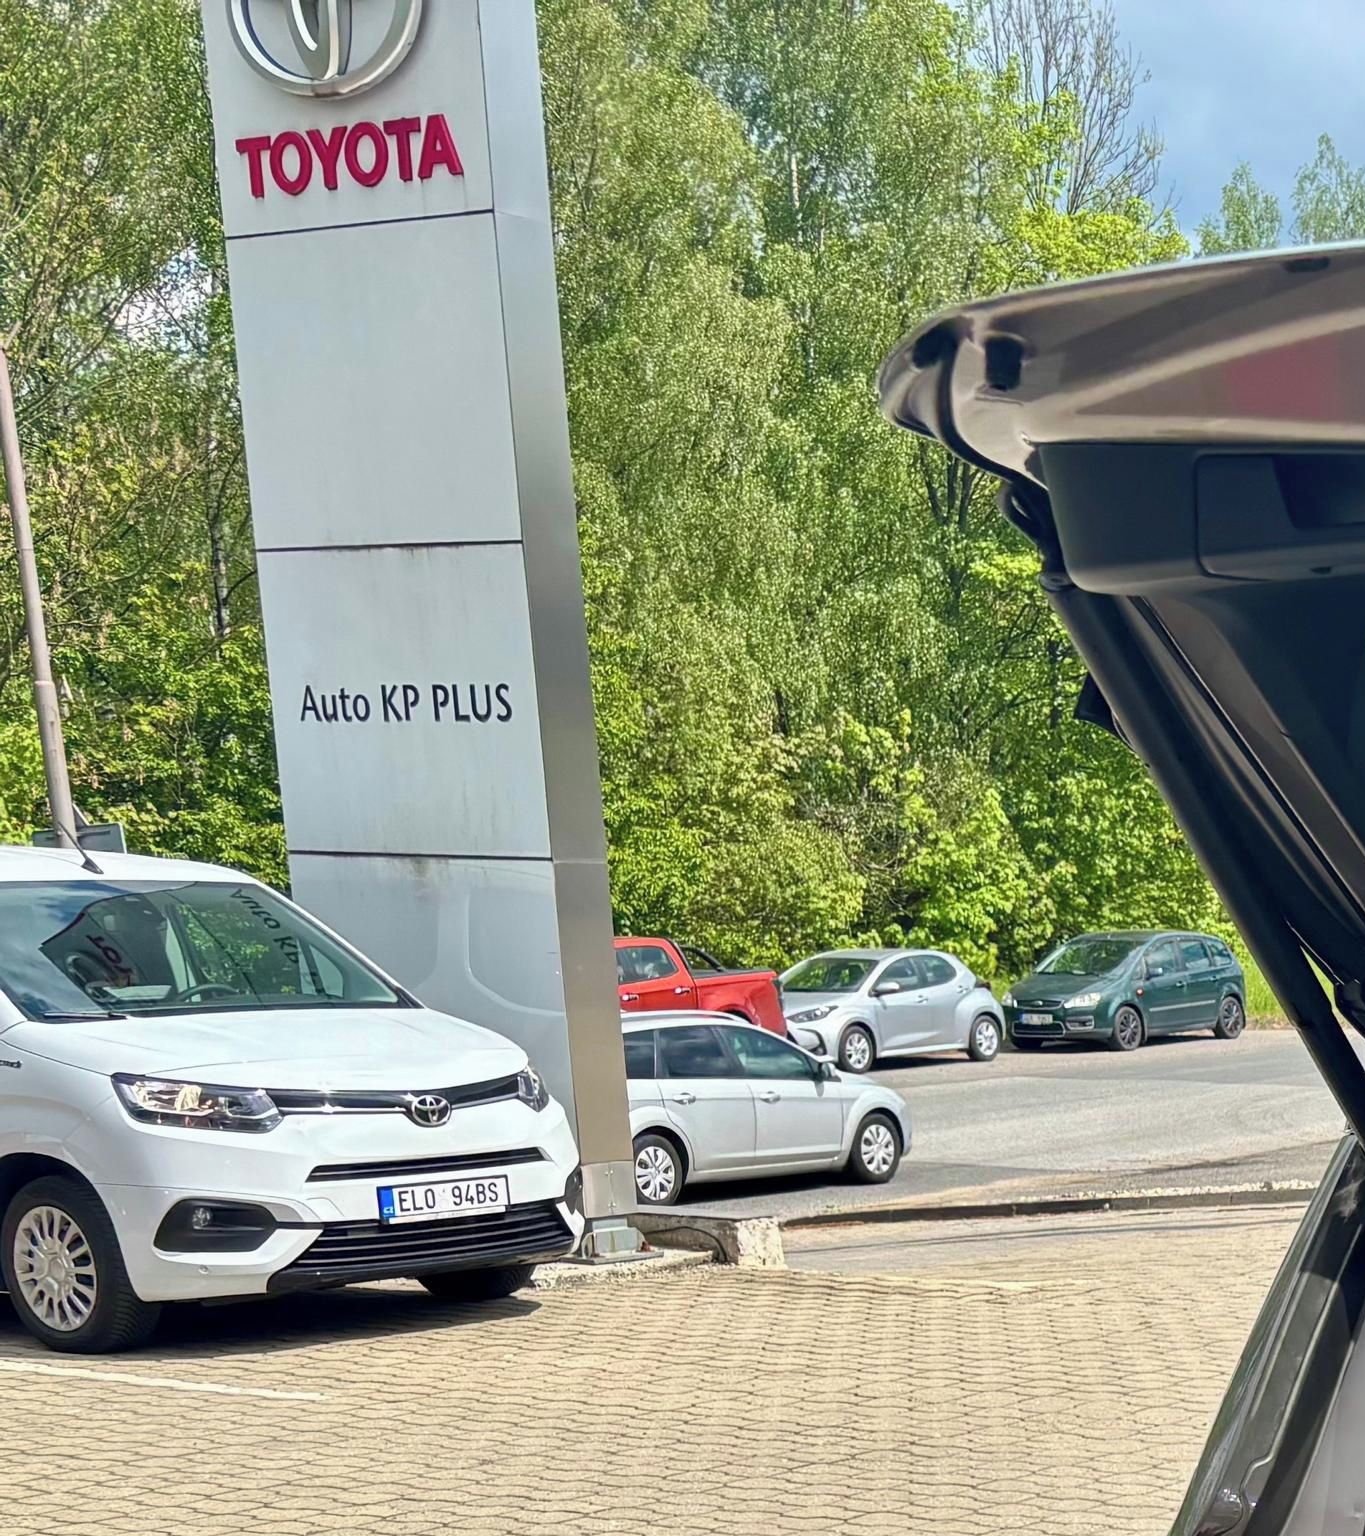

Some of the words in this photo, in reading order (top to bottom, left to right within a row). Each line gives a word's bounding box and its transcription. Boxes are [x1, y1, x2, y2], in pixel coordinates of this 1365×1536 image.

[235, 114, 464, 198] TOYOTA
[300, 685, 371, 722] Auto
[380, 684, 420, 722] KP
[431, 683, 513, 722] PLUS
[451, 1182, 499, 1207] 94BS
